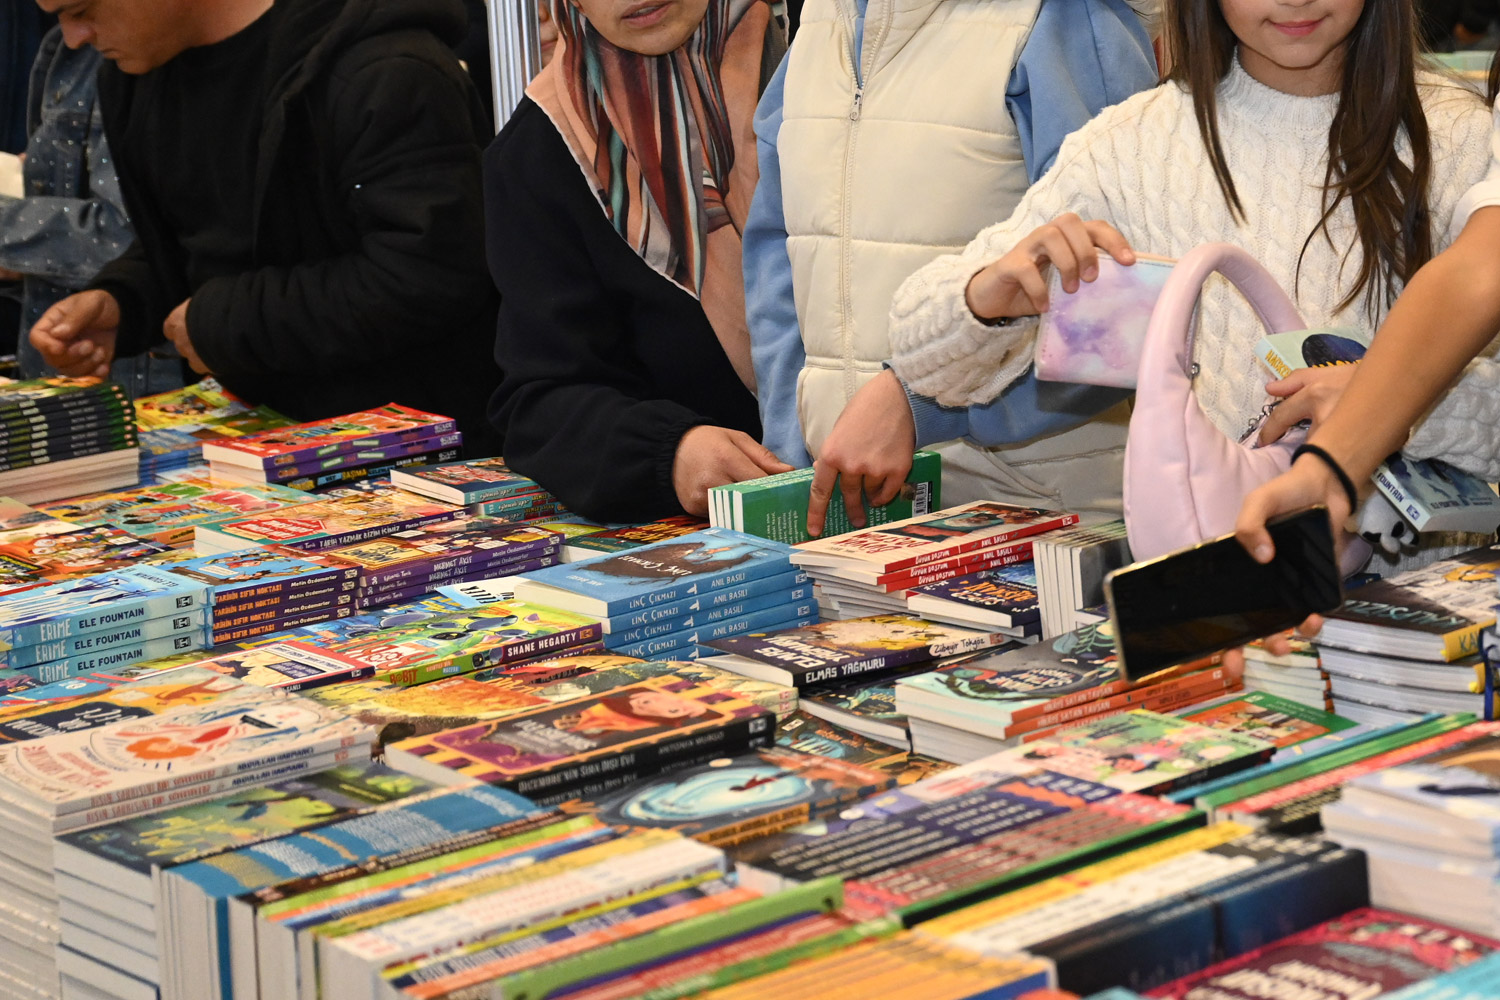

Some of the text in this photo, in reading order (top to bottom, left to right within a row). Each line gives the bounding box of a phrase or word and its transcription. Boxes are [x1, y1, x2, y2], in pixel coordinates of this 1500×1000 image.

[629, 572, 746, 610] LİNÇ ÇIKMAZI ANIL BASILI
[79, 617, 97, 629] ELE
[99, 607, 145, 625] FOUNTAIN
[631, 589, 748, 626] LİNÇ ÇIKMAZI ANIL BASILI
[624, 605, 743, 642] LİNÇ ÇIKMAZI ANIL BASILI
[75, 639, 93, 650] ELE
[96, 629, 141, 647] FOUNTAIN
[507, 631, 577, 657] SHANE HEGARTY
[649, 639, 677, 654] ÇIKMAZI
[712, 625, 727, 637] ANIL
[728, 621, 749, 633] BASILI
[77, 660, 95, 671] ELE
[98, 649, 143, 667] FOUNTAIN
[805, 657, 886, 684] ELMAS YAĞMURU
